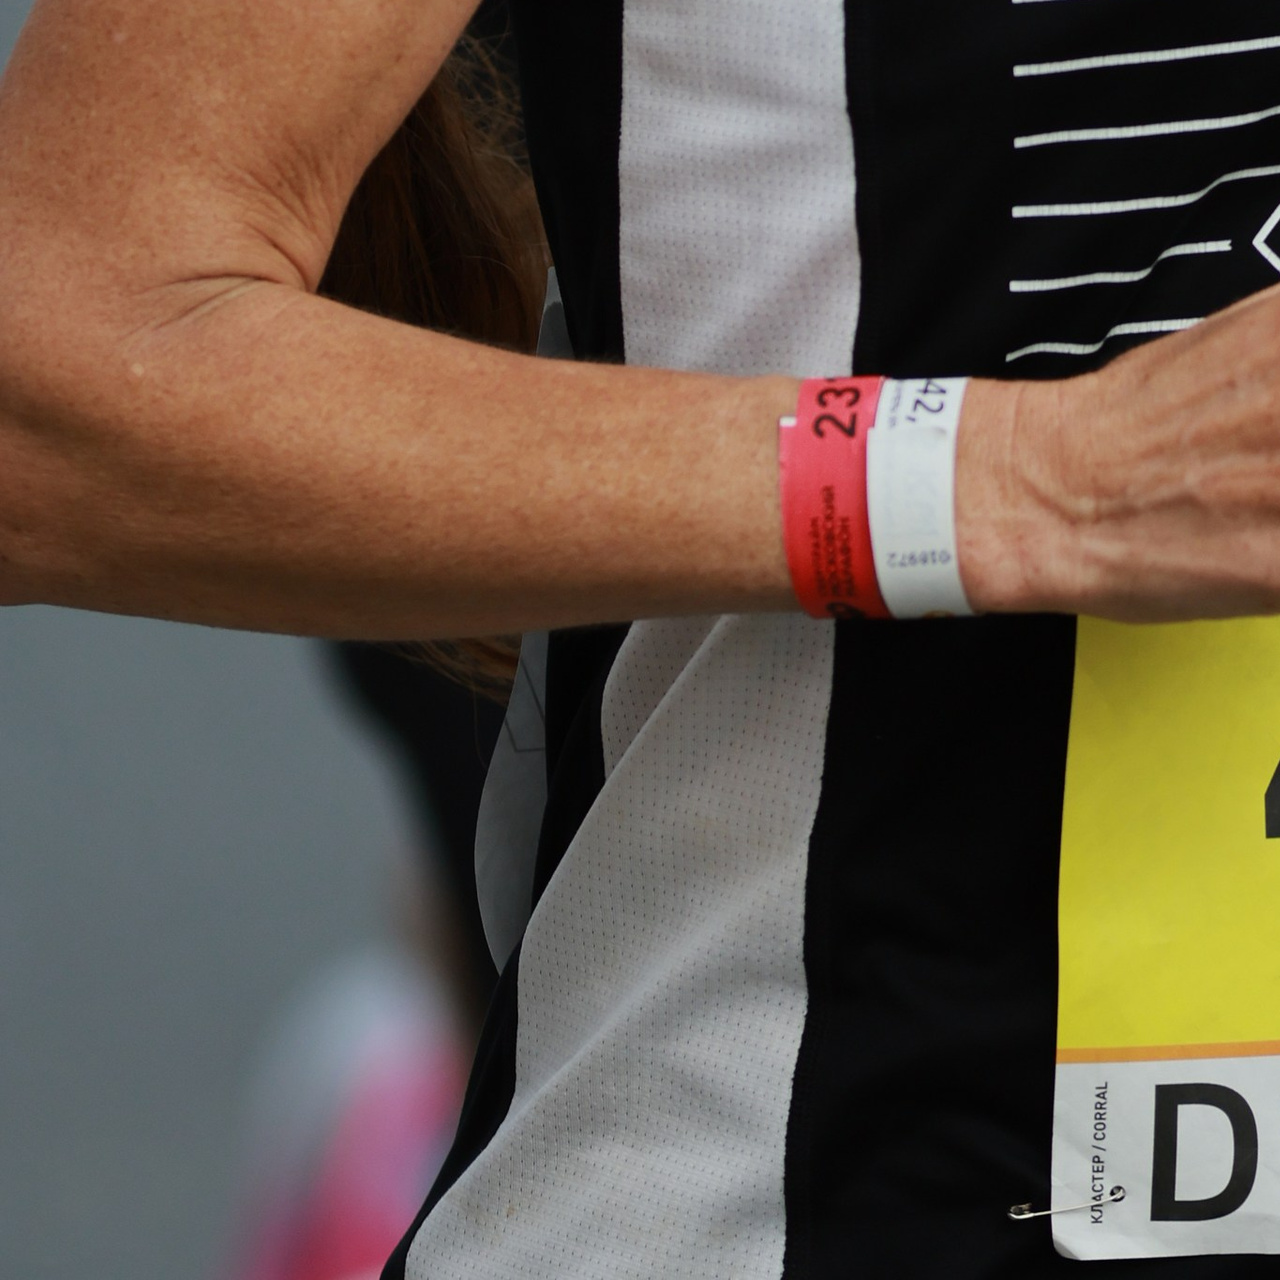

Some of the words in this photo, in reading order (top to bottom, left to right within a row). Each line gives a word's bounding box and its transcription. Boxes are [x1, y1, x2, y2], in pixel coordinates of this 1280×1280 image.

[812, 378, 861, 439] 23
[1093, 1081, 1108, 1141] CORRAL
[1150, 1082, 1258, 1222] D
[1091, 1155, 1105, 1224] КЛАСТЕР
